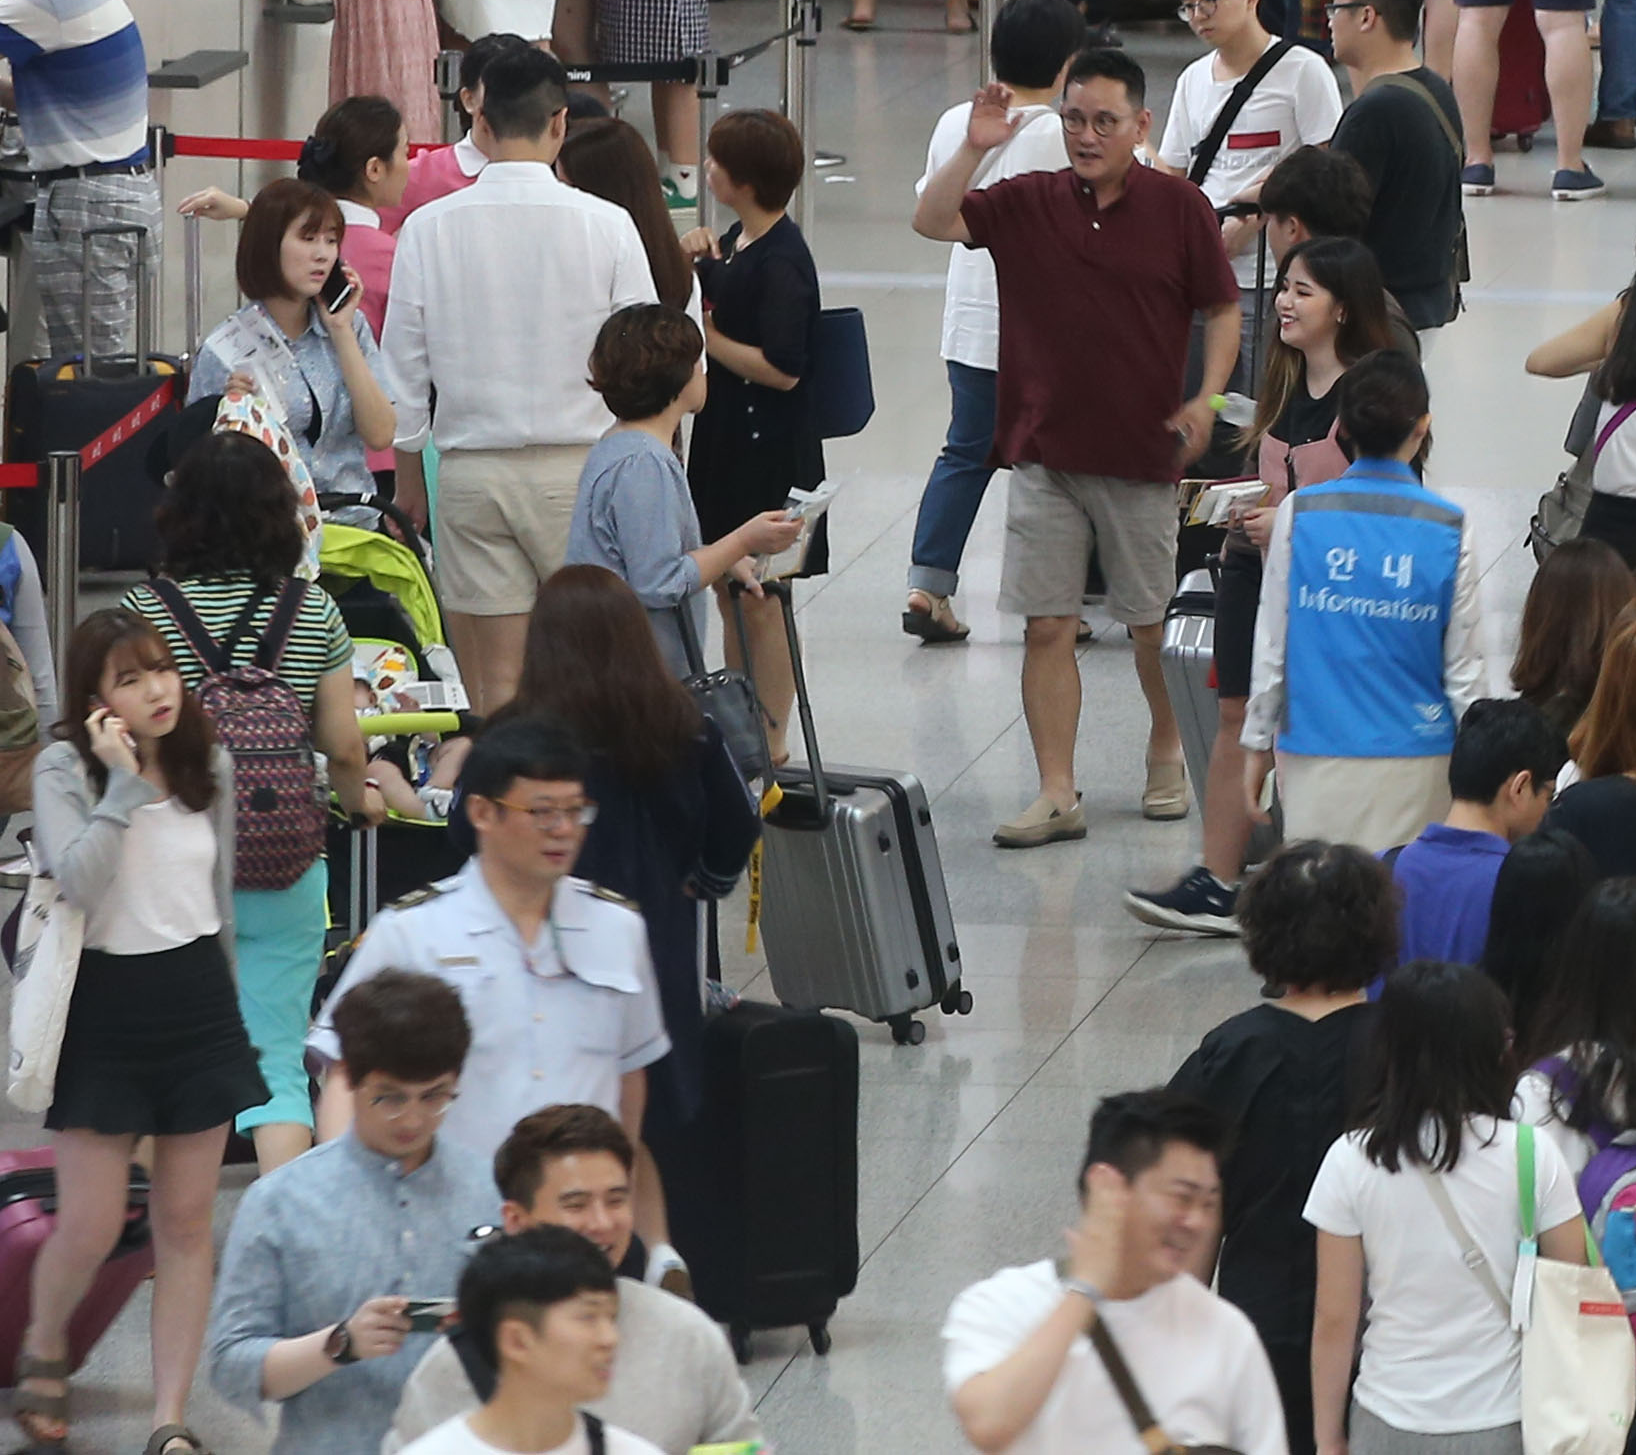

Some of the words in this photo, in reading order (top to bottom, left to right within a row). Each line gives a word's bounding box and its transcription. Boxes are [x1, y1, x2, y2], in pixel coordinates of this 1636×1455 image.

[1326, 547, 1359, 581] 안
[1382, 554, 1415, 590] 내
[1298, 584, 1440, 623] Information
